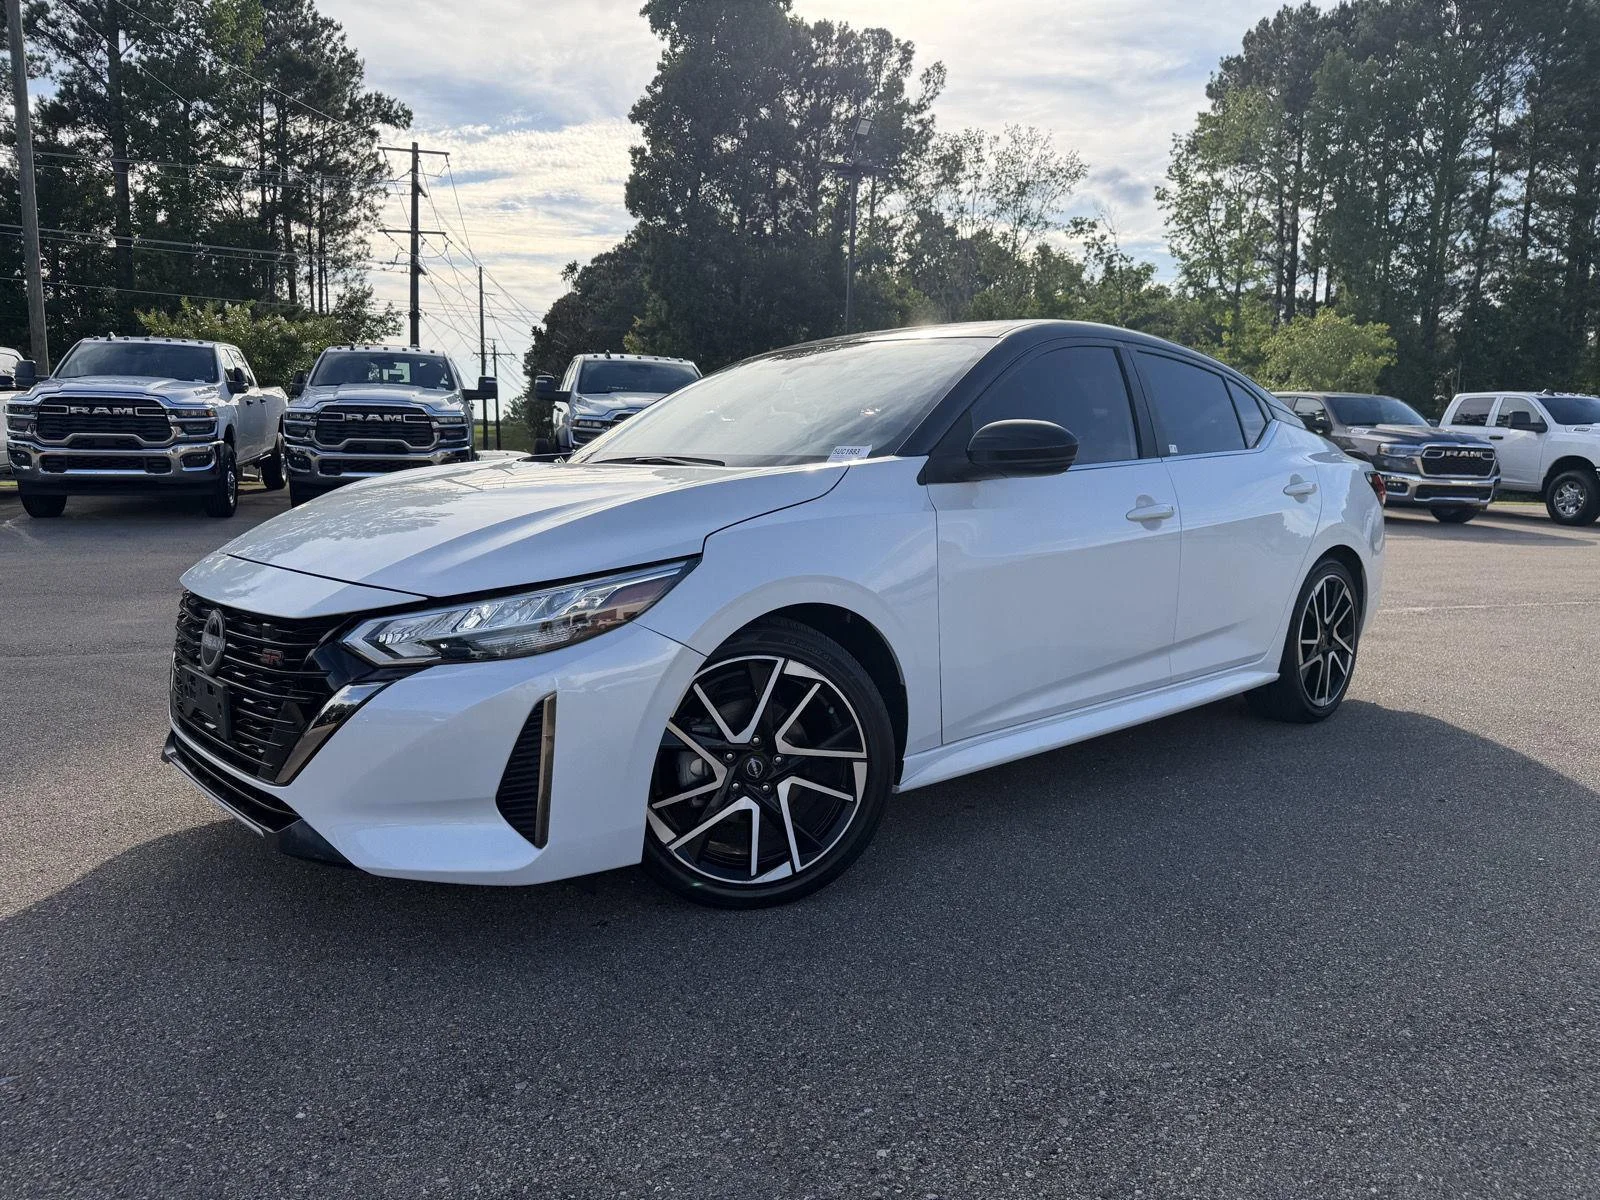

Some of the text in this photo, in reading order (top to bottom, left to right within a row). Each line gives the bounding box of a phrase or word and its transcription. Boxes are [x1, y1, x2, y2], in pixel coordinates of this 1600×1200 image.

[70, 406, 134, 415] RAM
[346, 413, 402, 422] RAM
[1445, 450, 1481, 458] RAM
